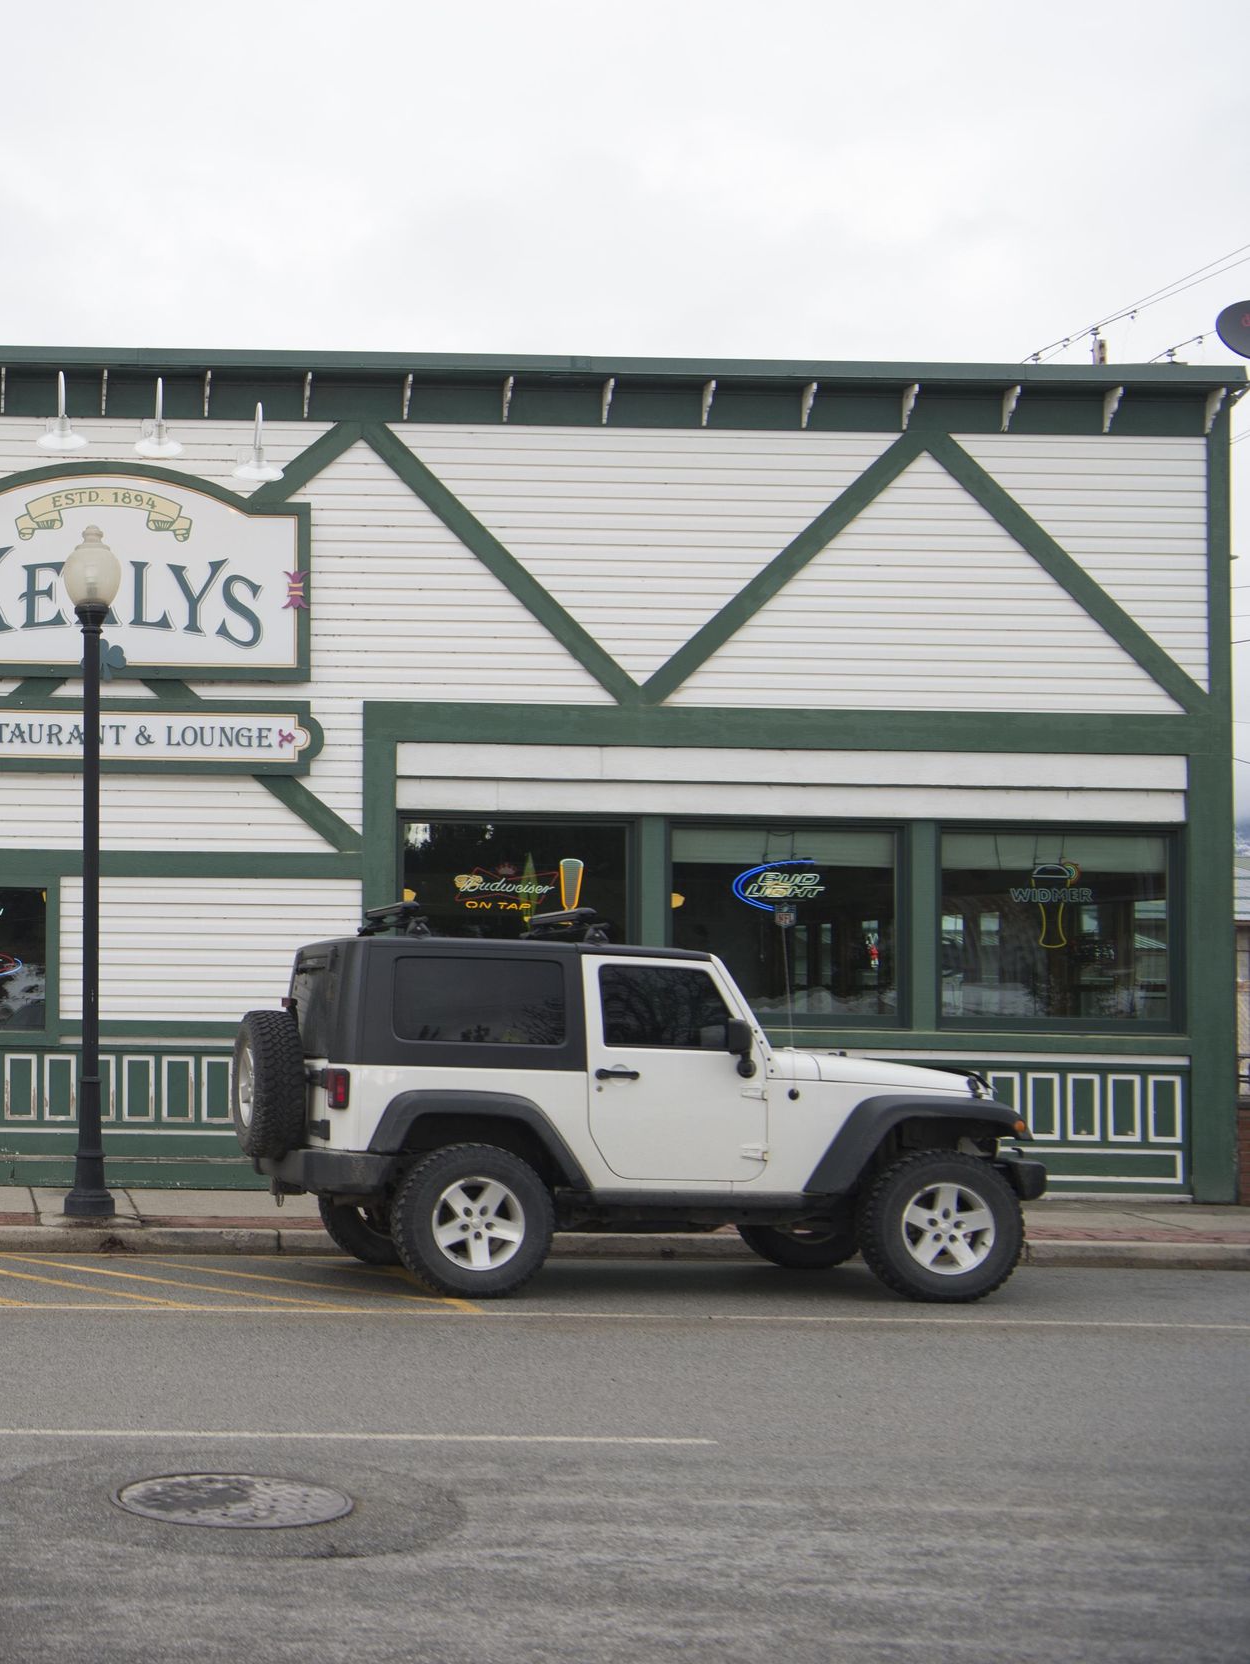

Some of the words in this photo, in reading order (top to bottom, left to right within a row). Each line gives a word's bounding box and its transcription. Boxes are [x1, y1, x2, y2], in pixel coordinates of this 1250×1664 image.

[52, 489, 105, 509] ESTD.
[112, 487, 157, 511] 1894
[135, 725, 155, 746] &
[166, 724, 273, 749] LOUNGE
[453, 874, 556, 895] Budweiser
[757, 871, 820, 886] BUD
[744, 883, 826, 898] LIGHT
[1010, 887, 1093, 904] WIDMER
[465, 900, 492, 910] ON
[498, 901, 532, 911] TAP
